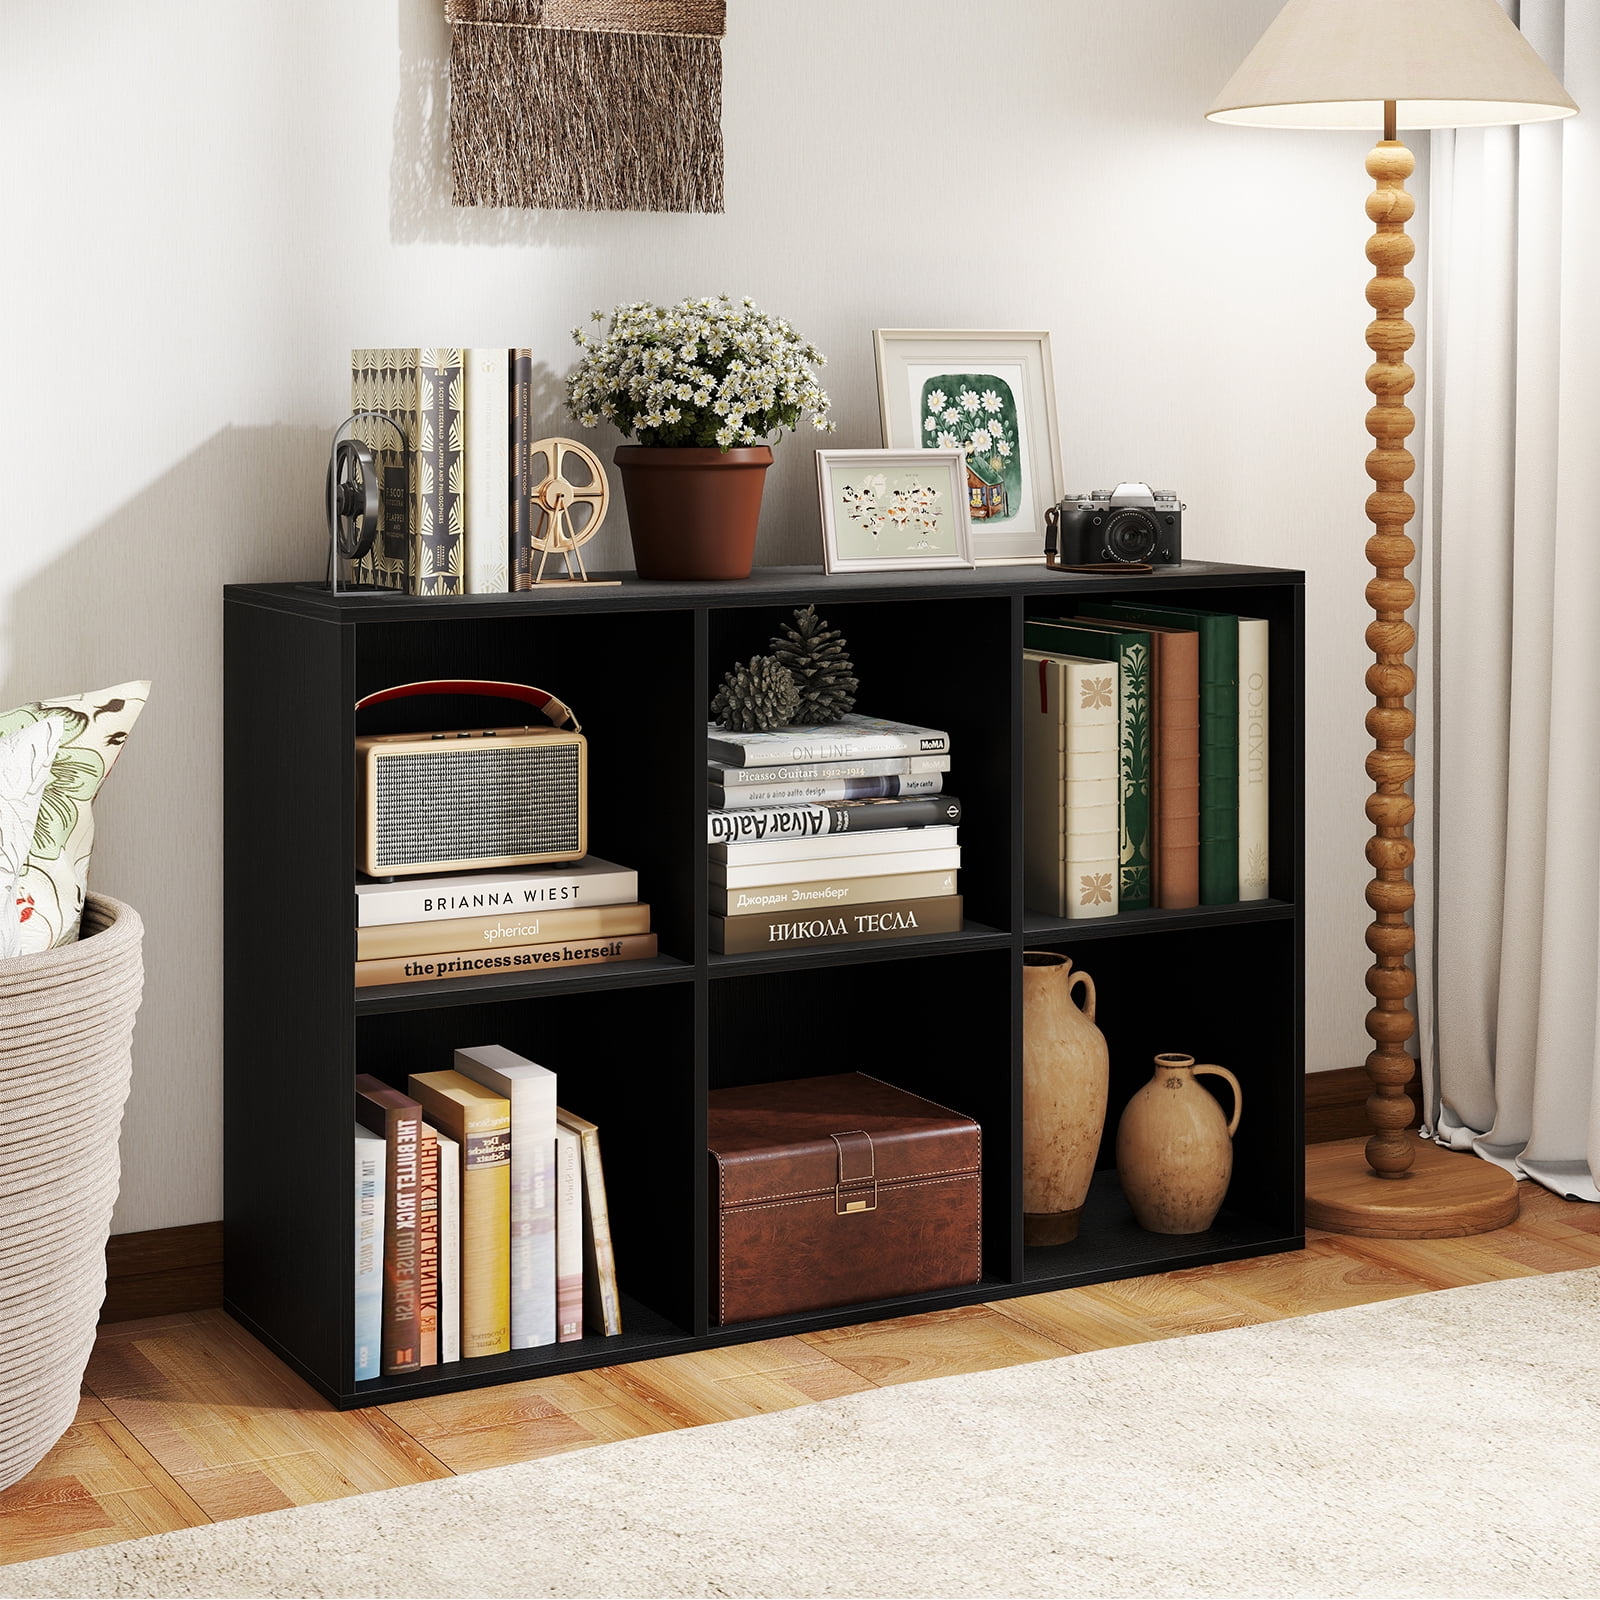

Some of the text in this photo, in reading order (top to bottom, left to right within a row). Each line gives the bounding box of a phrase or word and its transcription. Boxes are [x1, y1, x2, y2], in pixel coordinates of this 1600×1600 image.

[1248, 672, 1265, 784] LUXDECO
[792, 746, 814, 761] ON
[821, 744, 853, 759] LINE
[922, 740, 944, 750] MoMA
[738, 768, 776, 782] Picasso
[778, 767, 818, 780] Guitars
[922, 760, 945, 769] MoMA
[749, 792, 766, 800] alvar
[772, 790, 786, 798] aino
[806, 786, 826, 797] design
[906, 780, 919, 789] hatje
[712, 814, 767, 842] Aalto
[770, 810, 823, 835] Alvar
[424, 885, 581, 912] BRIANNA WIEST
[737, 887, 850, 908] Джордан Элленберг
[483, 920, 540, 944] spherical
[768, 911, 919, 942] НИКОЛА ТЕСЛА
[404, 941, 623, 978] the princess saves herself
